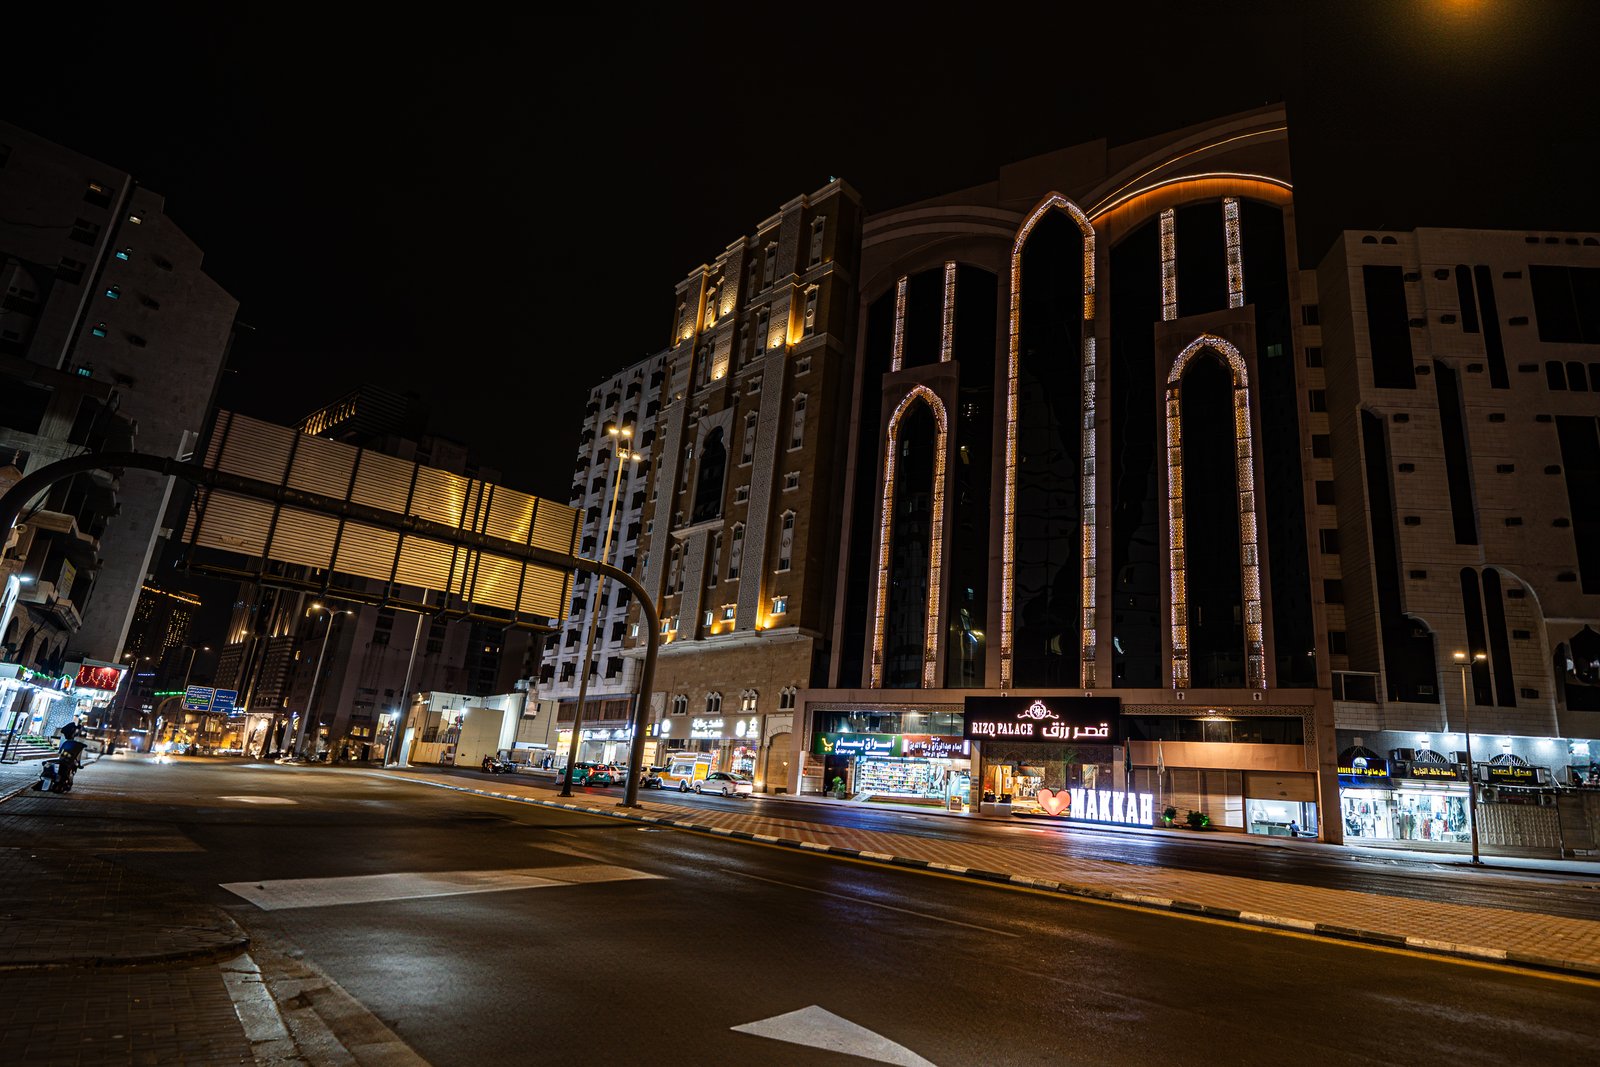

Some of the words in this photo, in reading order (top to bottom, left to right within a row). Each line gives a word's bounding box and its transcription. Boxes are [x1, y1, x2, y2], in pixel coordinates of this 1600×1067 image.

[972, 722, 996, 737] RIZQ
[997, 723, 1033, 735] PALACE
[1042, 722, 1071, 738] رزق
[1073, 722, 1109, 739] قصر
[835, 737, 865, 750] بسام
[864, 736, 896, 751] أسواق
[1440, 767, 1457, 777] مؤسسة
[1492, 765, 1513, 775] أحمد
[1070, 788, 1153, 825] MAKKAH
